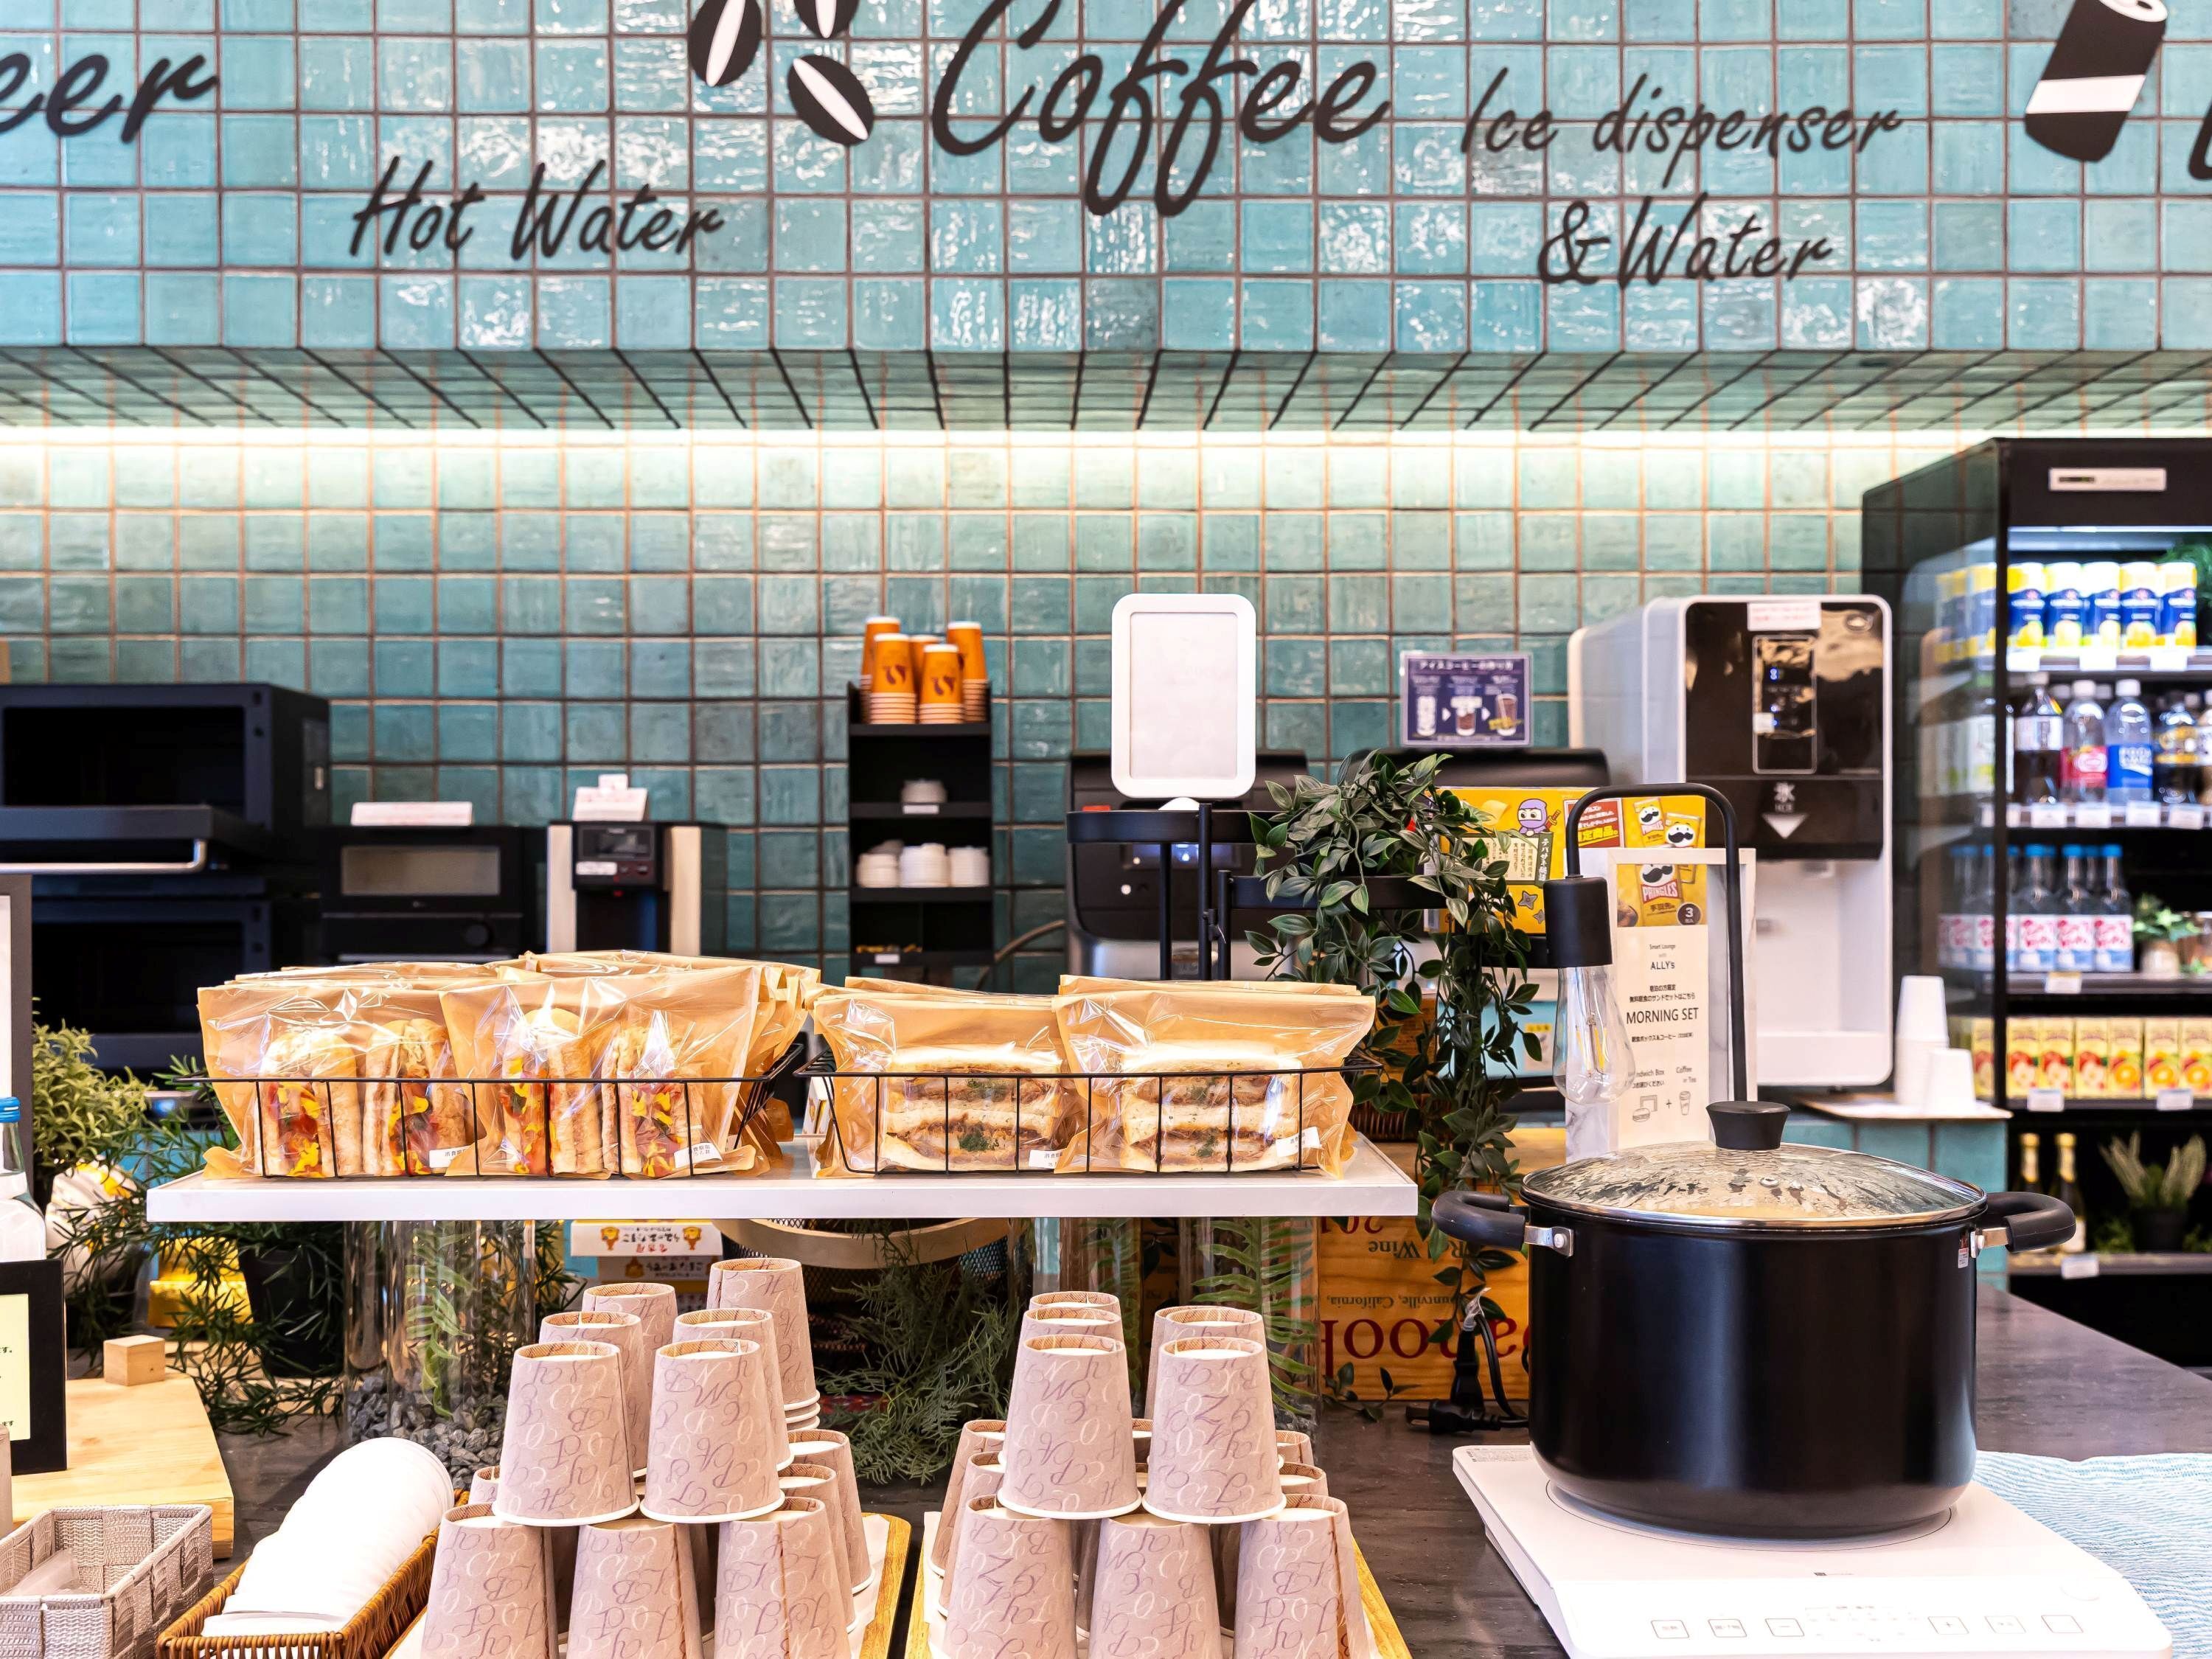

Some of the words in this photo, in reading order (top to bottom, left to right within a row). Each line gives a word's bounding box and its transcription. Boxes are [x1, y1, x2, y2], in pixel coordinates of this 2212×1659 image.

[932, 0, 1389, 217] Coffee
[1461, 68, 1559, 153] Ice
[1593, 72, 1902, 187] dispenser
[349, 156, 481, 257] Hot
[511, 160, 724, 260] Water
[1642, 880, 1679, 902] PRINGLES
[1685, 907, 1694, 918] 3
[1627, 1008, 1679, 1024] MORNING
[1682, 1007, 1699, 1020] SET
[1676, 1065, 1693, 1074] Coffee
[1368, 1240, 1422, 1259] Wine
[1326, 1294, 1394, 1310] California,
[1399, 1294, 1454, 1310] ountville,
